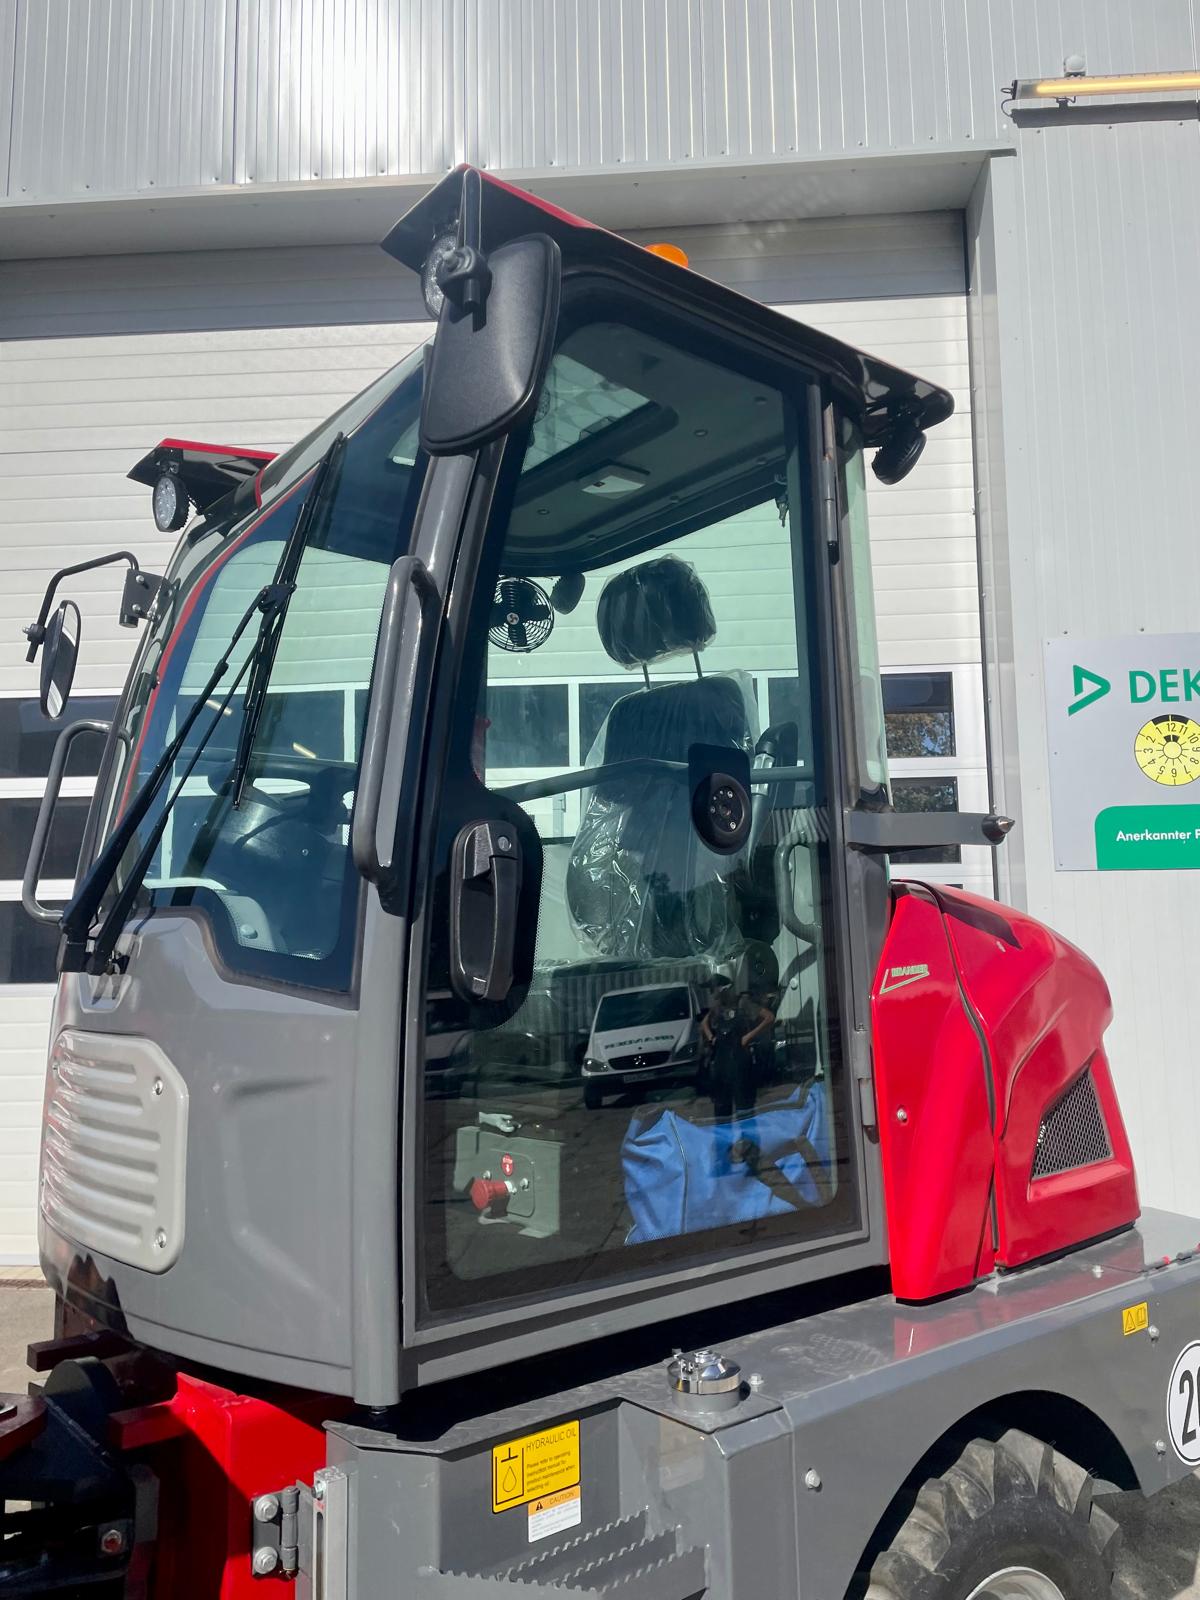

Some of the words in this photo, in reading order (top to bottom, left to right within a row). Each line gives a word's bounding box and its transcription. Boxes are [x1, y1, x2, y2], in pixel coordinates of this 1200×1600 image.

[1166, 722, 1177, 732] 12
[1116, 828, 1192, 842] Anerkannter
[1179, 1366, 1200, 1447] 2
[526, 1431, 565, 1452] HYDRAULIC
[566, 1427, 577, 1439] OIL
